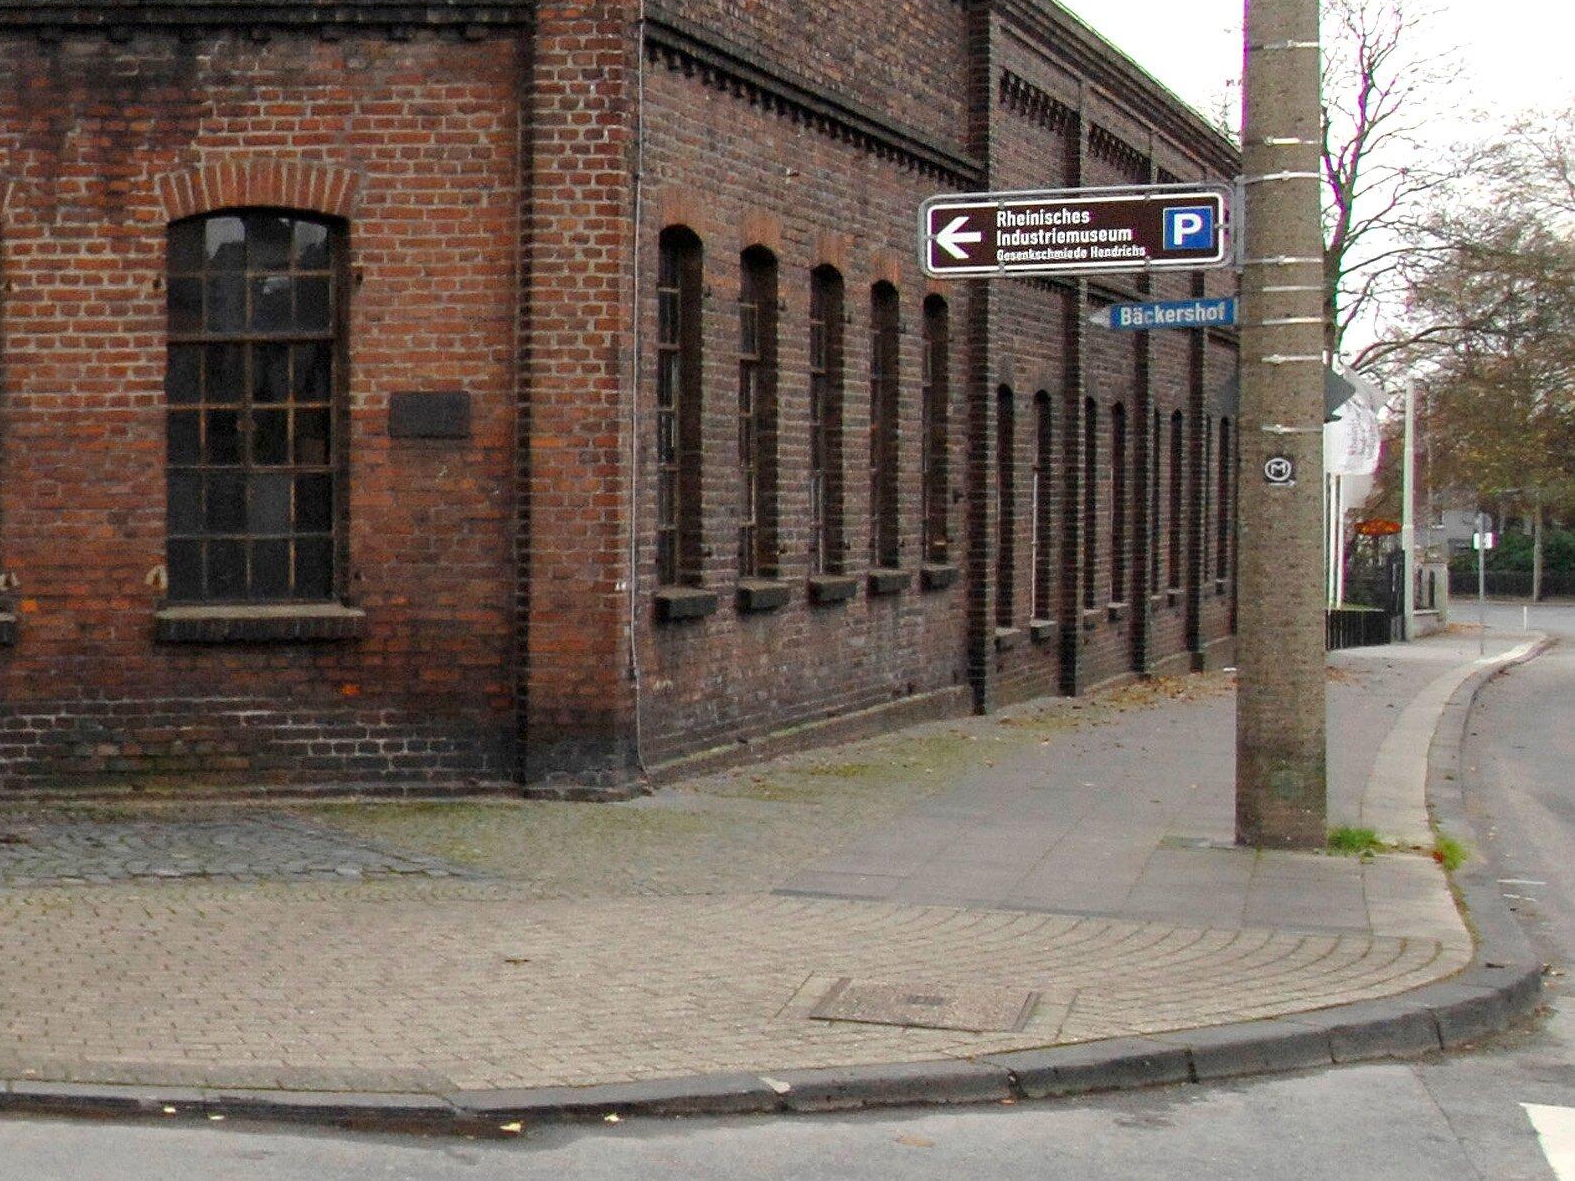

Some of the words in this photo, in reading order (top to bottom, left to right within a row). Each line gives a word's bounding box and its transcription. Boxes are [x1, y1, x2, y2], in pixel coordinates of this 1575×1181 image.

[996, 208, 1091, 227] Rheinisches
[996, 227, 1133, 247] Industriemuseum
[1173, 213, 1203, 245] P
[996, 247, 1088, 261] Gesenkschmiede
[1090, 244, 1146, 259] Hendrichs
[1120, 301, 1227, 326] Bäckershof
